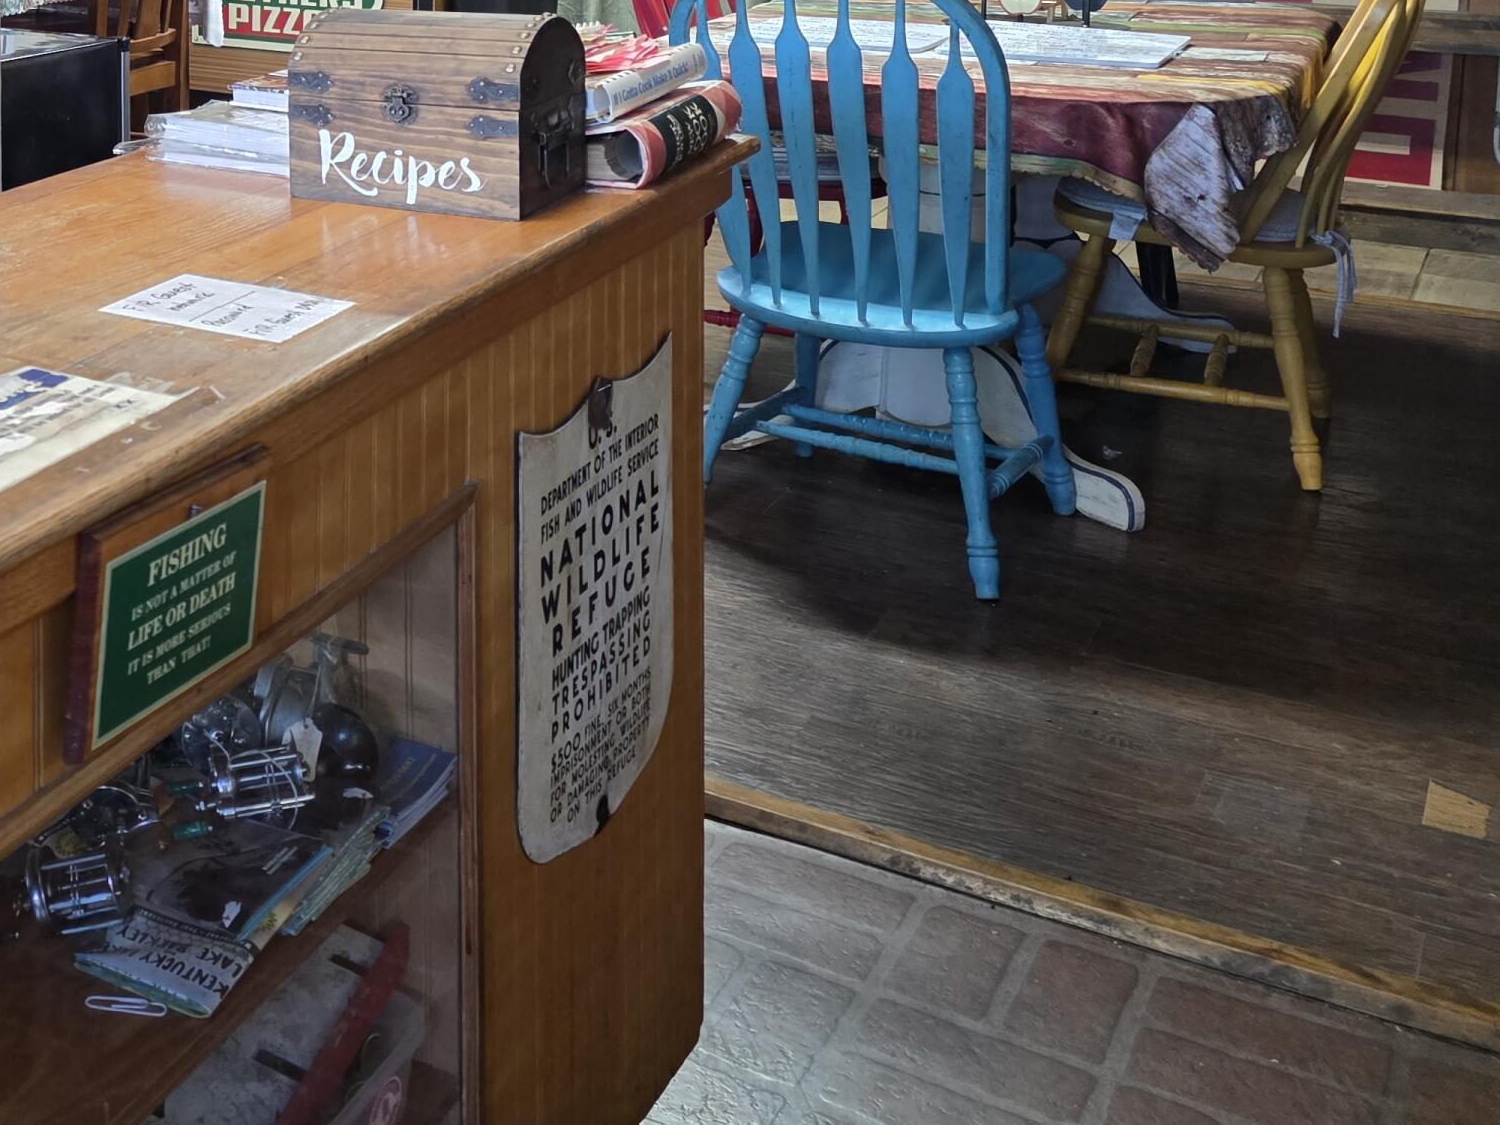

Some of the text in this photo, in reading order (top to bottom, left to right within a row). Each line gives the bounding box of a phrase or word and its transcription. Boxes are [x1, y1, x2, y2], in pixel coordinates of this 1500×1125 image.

[622, 83, 639, 101] Gotta
[638, 77, 653, 94] Cook
[653, 72, 669, 89] Make
[317, 127, 489, 205] Recipes
[540, 413, 659, 517] DEPARTMENT OF THE INTERIOR
[541, 438, 659, 546] FISH AND WILDLIFE SERVICE
[147, 522, 228, 587] FISHING
[540, 470, 659, 588] NATIONAL
[541, 502, 659, 624] WILDLIFE
[127, 572, 237, 652] LIFE OR DEATH
[127, 602, 232, 676] IT IS MORE SERIOUS
[131, 551, 237, 622] IS NOT A MATTER OF
[552, 585, 650, 692] HUNTING TRAPPING
[553, 546, 650, 658] REFUGE
[147, 635, 212, 685] THAN THAT!
[552, 610, 650, 716] TRESPASSING
[552, 636, 651, 745] PROHIBITED
[550, 682, 651, 791] IMPRISONMENT OR BOTH
[550, 697, 651, 807] FOR MOLESTING WILDLIFE
[550, 716, 650, 823] OR DAMAGING PROPERTY
[551, 665, 651, 774] $500 SIX MONTHS
[567, 745, 637, 824] ON THIS REFUGE
[138, 952, 229, 1000] KENTUCKY
[196, 947, 243, 979] LAKE
